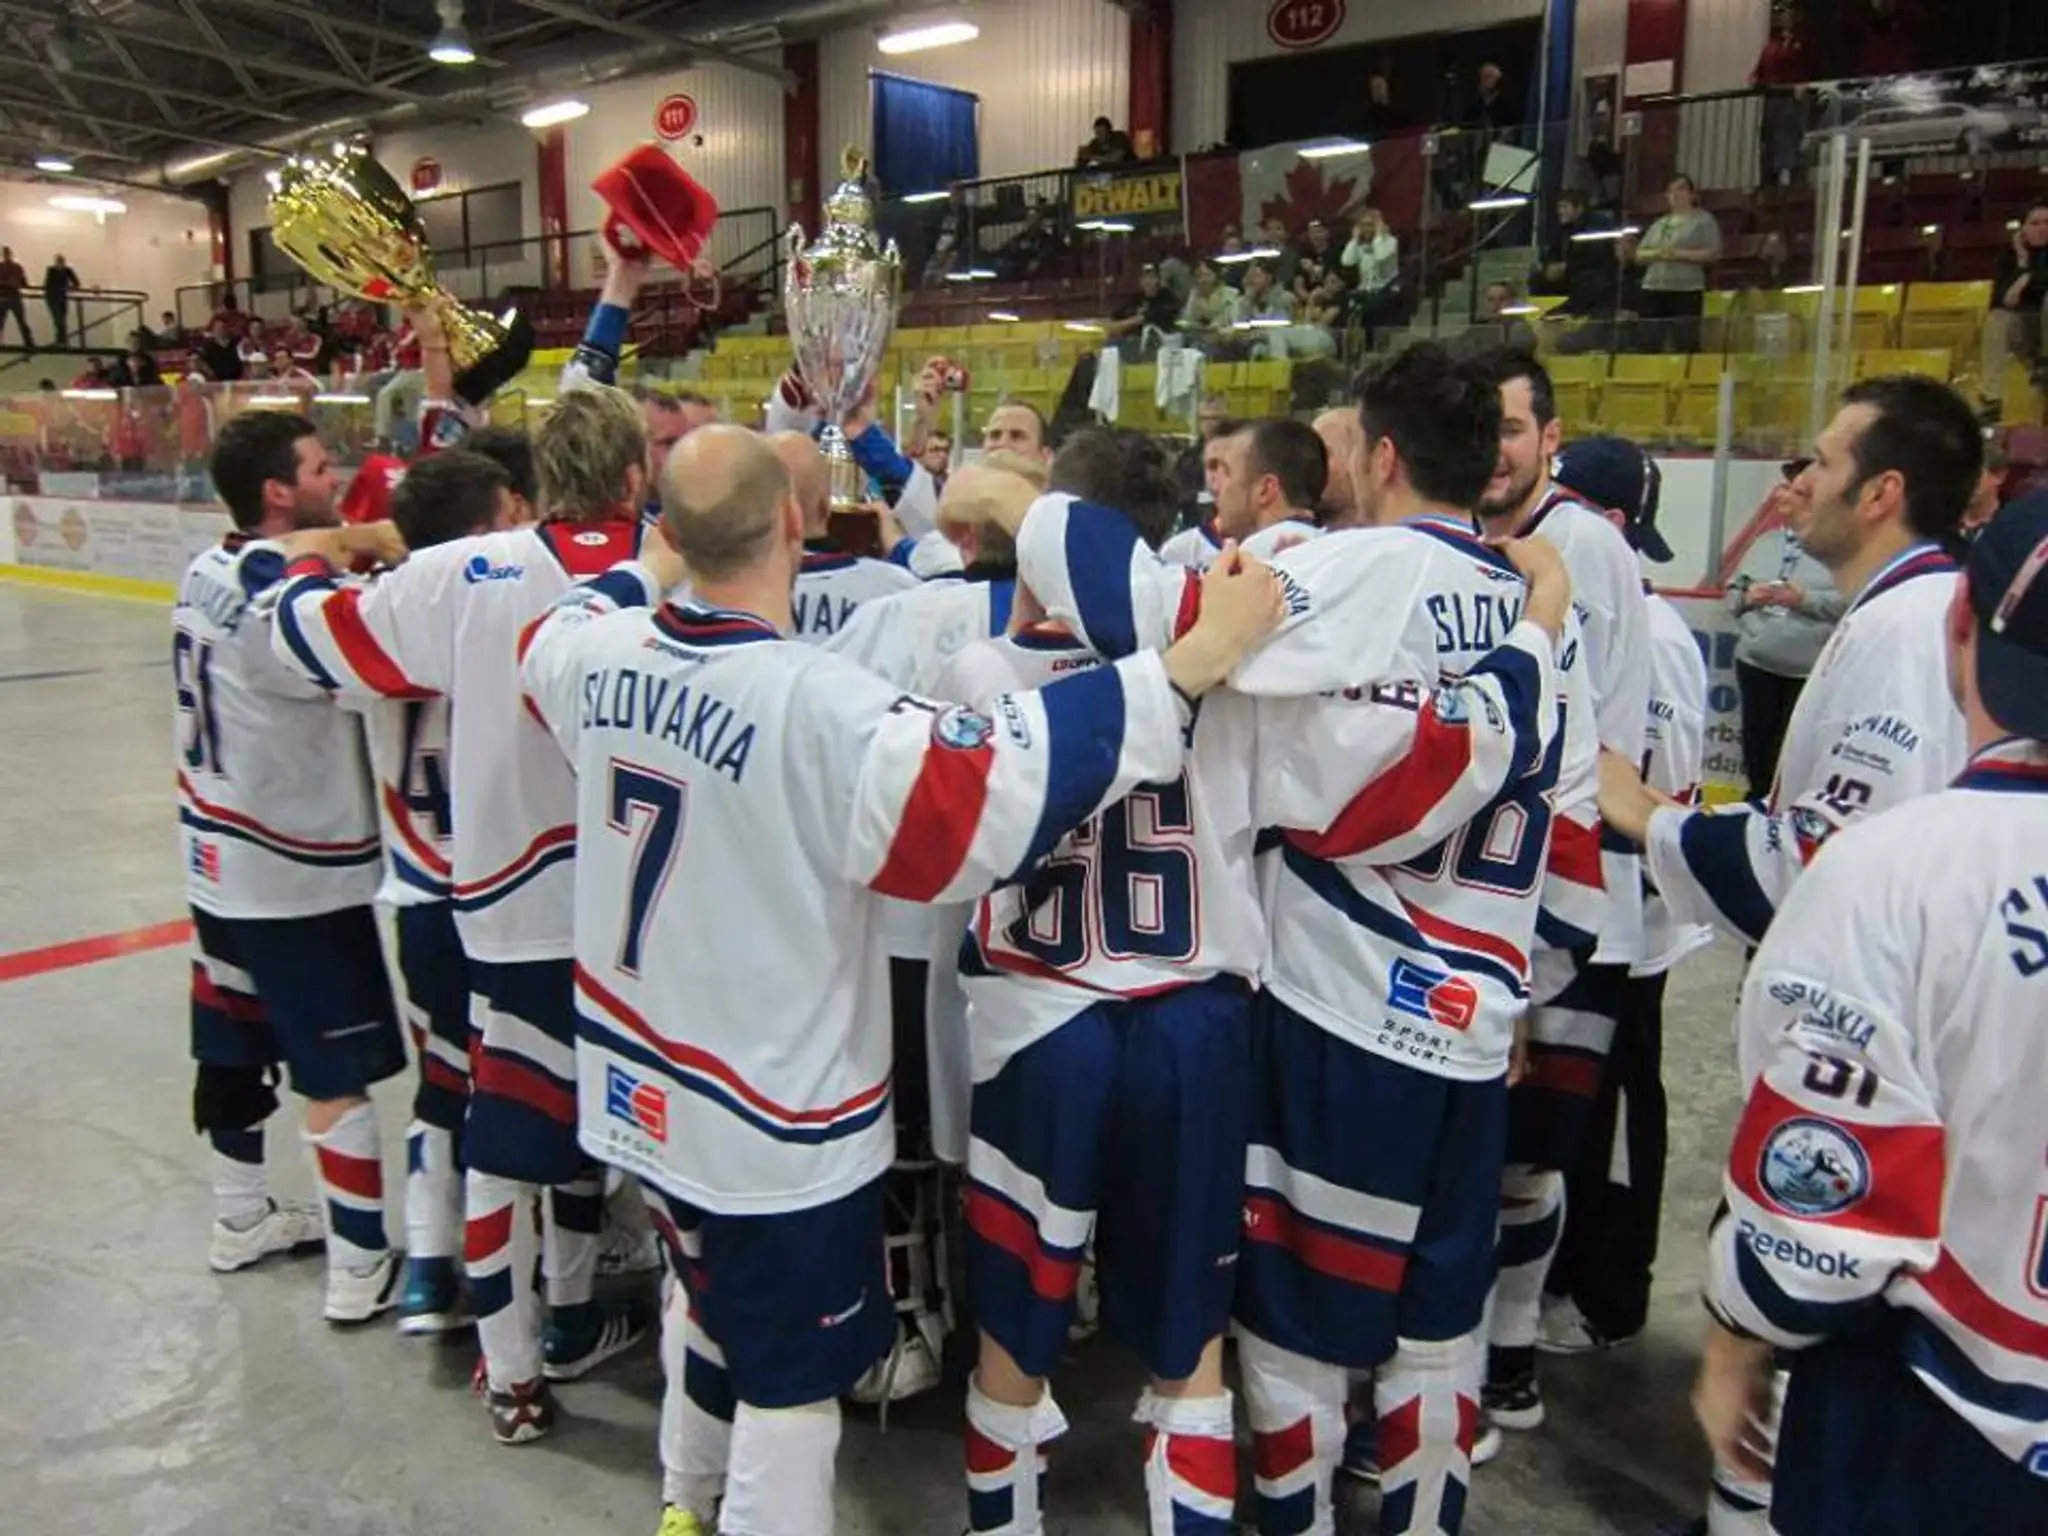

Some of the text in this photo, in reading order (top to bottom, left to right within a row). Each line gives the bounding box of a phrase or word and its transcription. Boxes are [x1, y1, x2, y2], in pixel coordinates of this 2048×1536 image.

[1287, 4, 1323, 33] 112
[663, 106, 685, 126] 111
[582, 667, 757, 784] SLOVAKIA
[606, 756, 690, 981] 7
[1377, 1033, 1448, 1065] COURT
[1384, 1018, 1452, 1051] SPORT
[1738, 1219, 1861, 1279] Reebok
